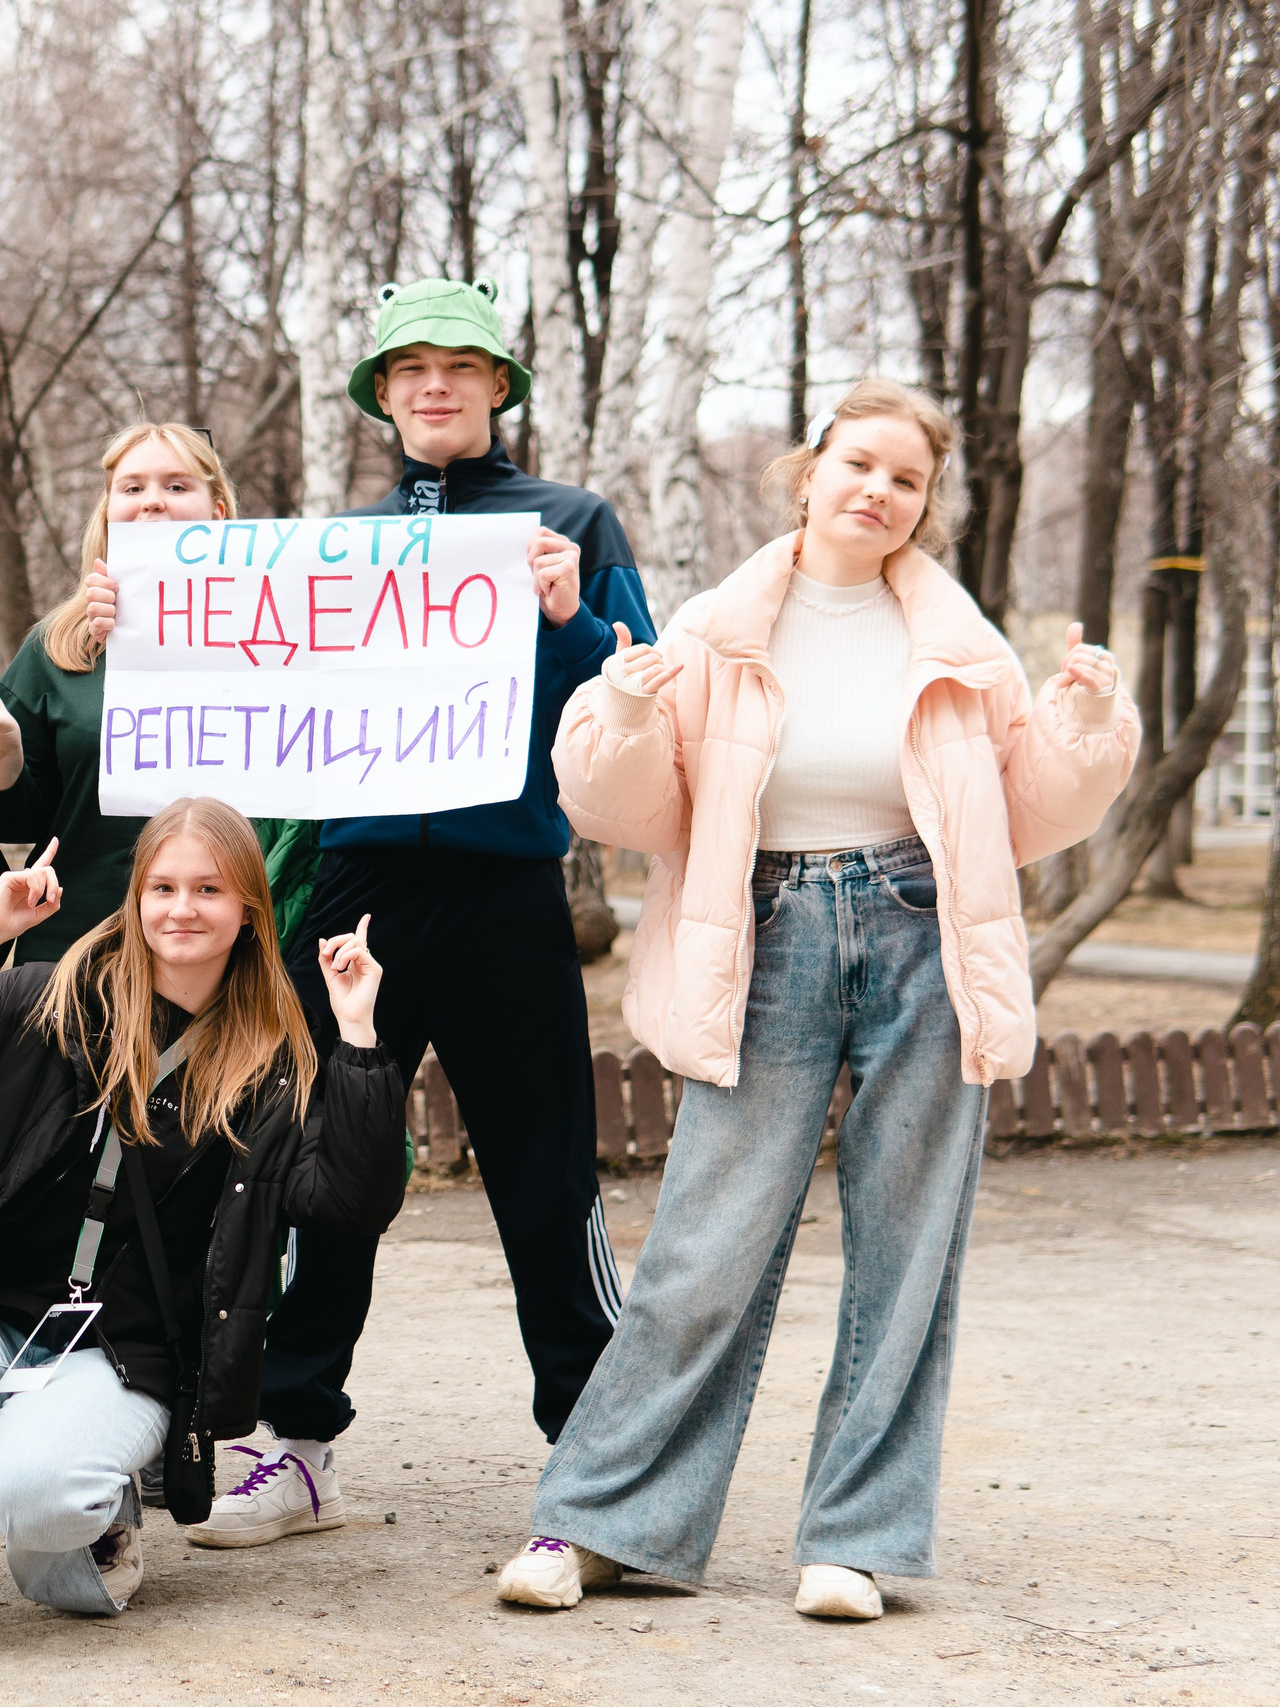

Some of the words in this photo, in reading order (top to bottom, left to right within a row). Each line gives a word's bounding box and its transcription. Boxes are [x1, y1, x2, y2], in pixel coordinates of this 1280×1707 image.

[176, 517, 433, 570] СПУСТЯ
[158, 569, 498, 667] НЕДЕЛЮ
[106, 677, 518, 784] РЕПЕТИЦИЙ!
